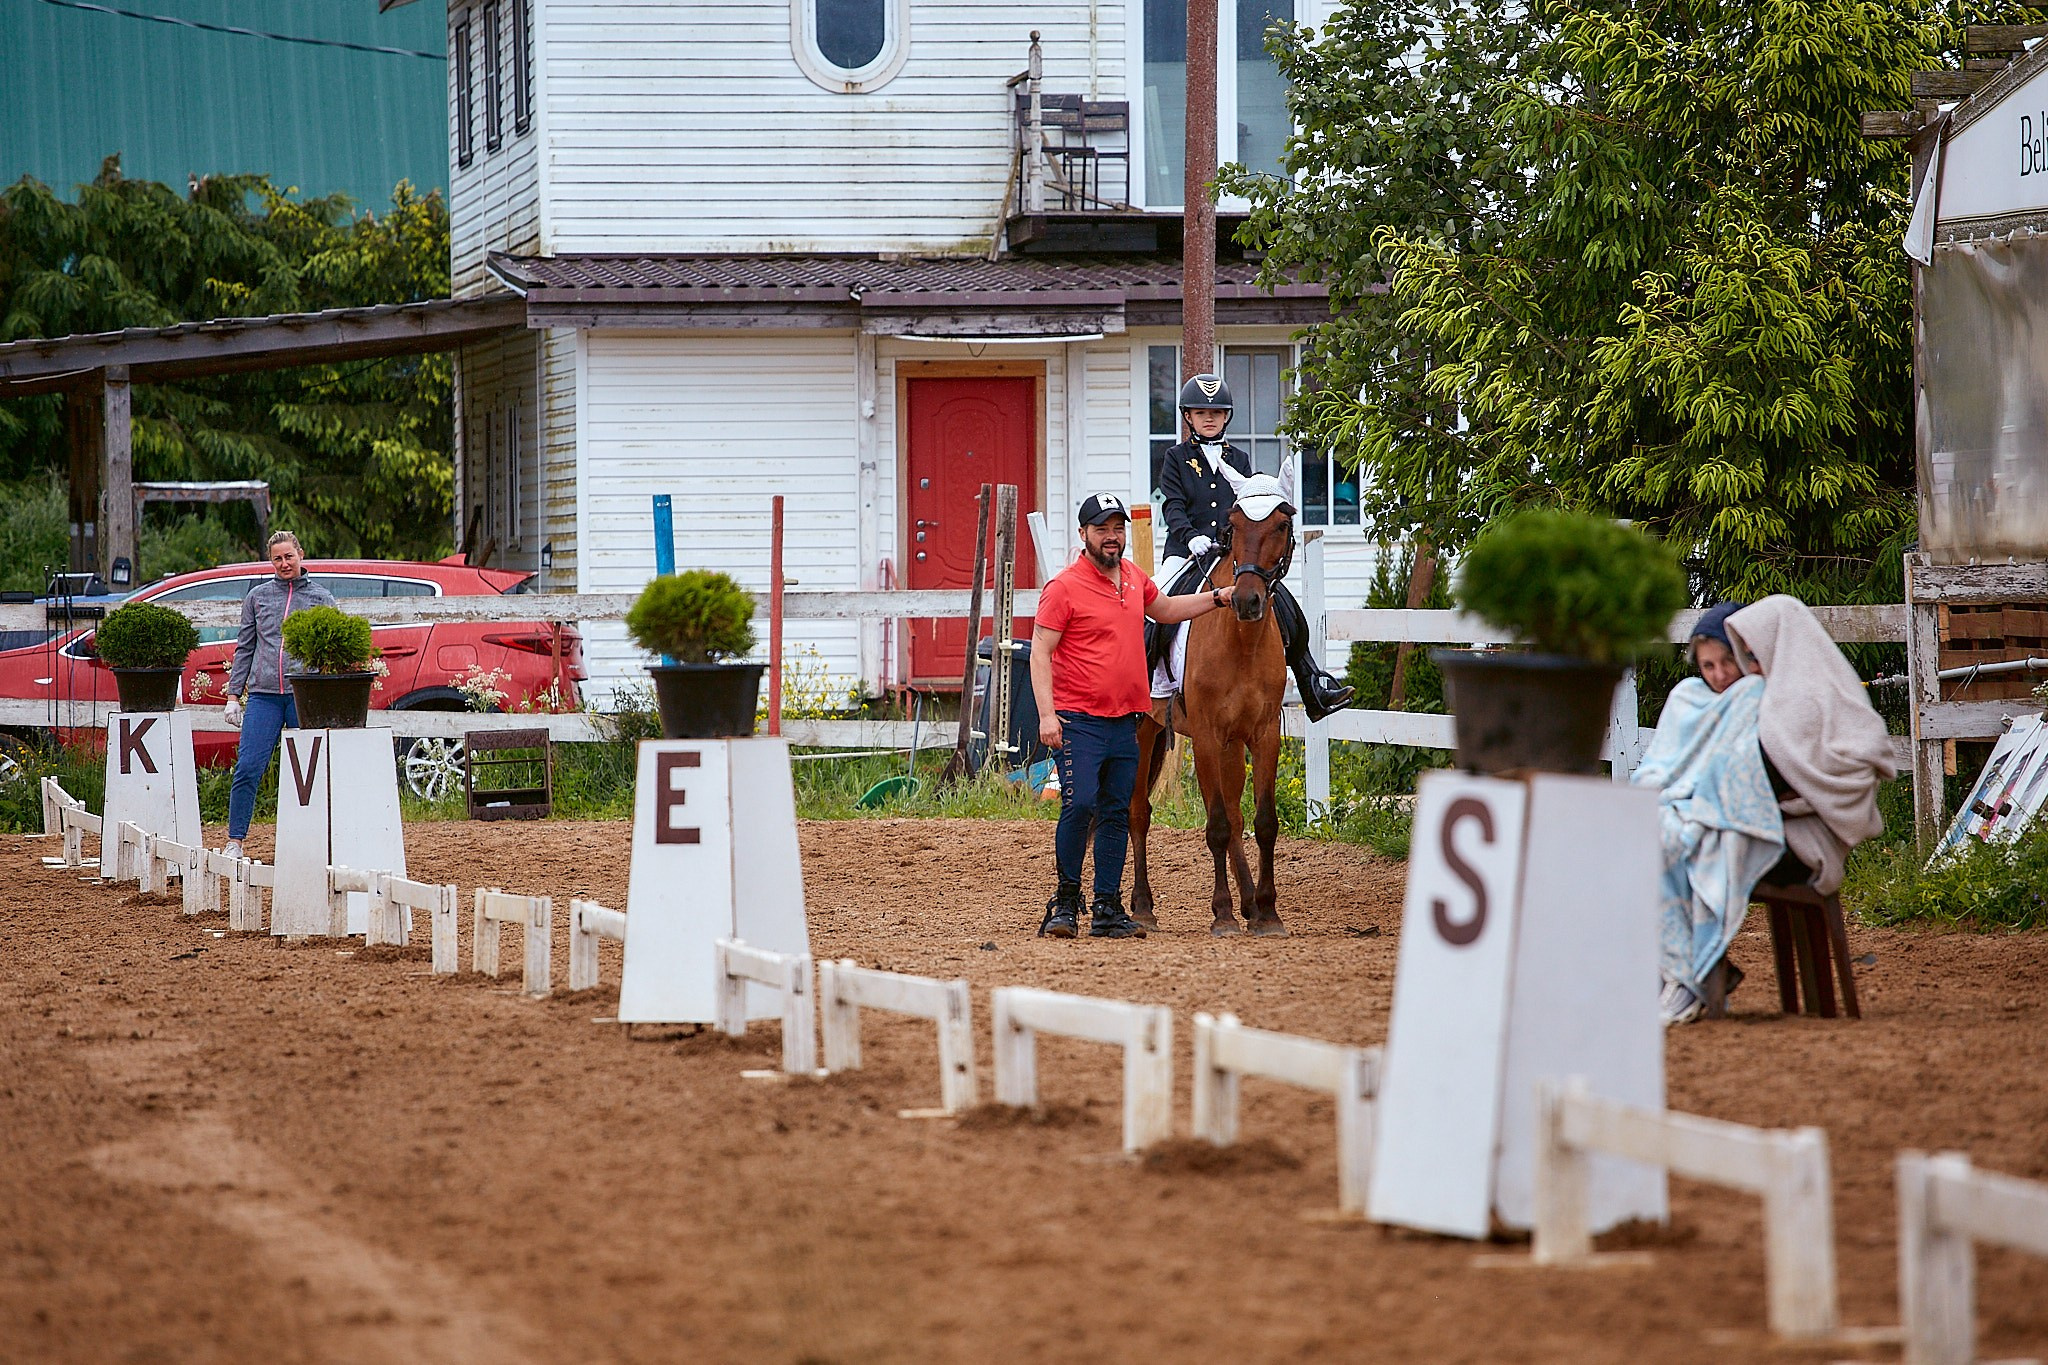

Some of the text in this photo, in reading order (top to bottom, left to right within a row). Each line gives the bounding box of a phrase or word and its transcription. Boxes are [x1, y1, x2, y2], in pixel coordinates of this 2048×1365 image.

[119, 718, 159, 774] K
[285, 736, 323, 807] V
[1063, 738, 1074, 807] AUBRION
[656, 751, 701, 844] E
[1433, 798, 1495, 945] S
